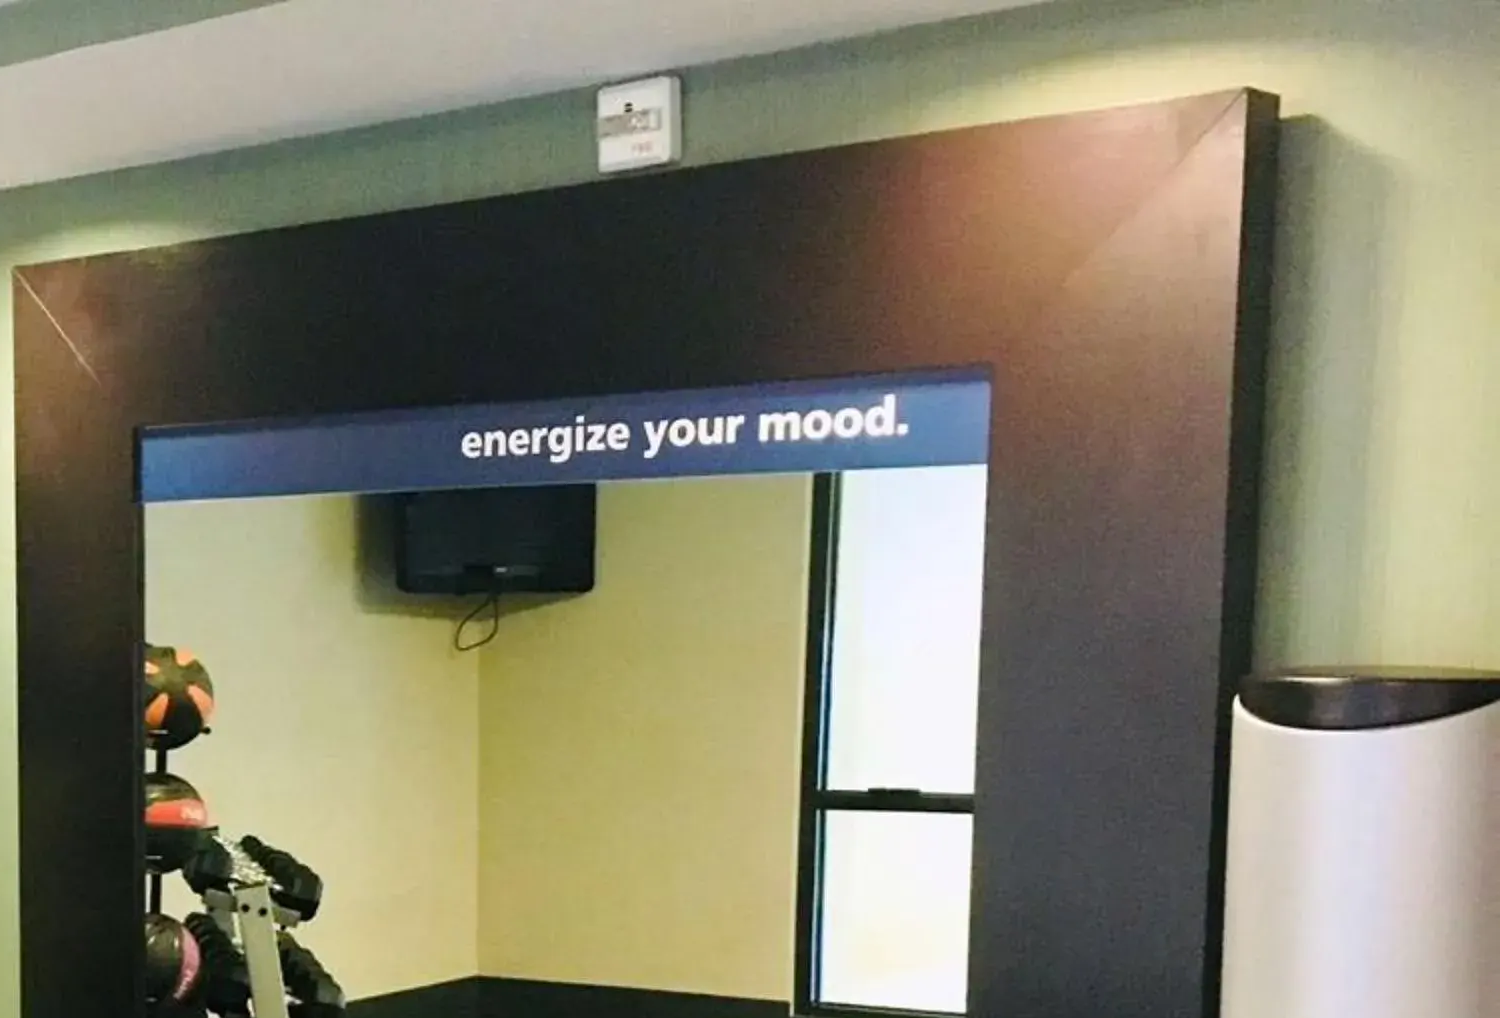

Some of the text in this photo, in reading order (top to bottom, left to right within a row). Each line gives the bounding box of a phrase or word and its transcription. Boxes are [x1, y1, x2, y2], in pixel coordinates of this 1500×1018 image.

[461, 393, 910, 463] energize your mood.
